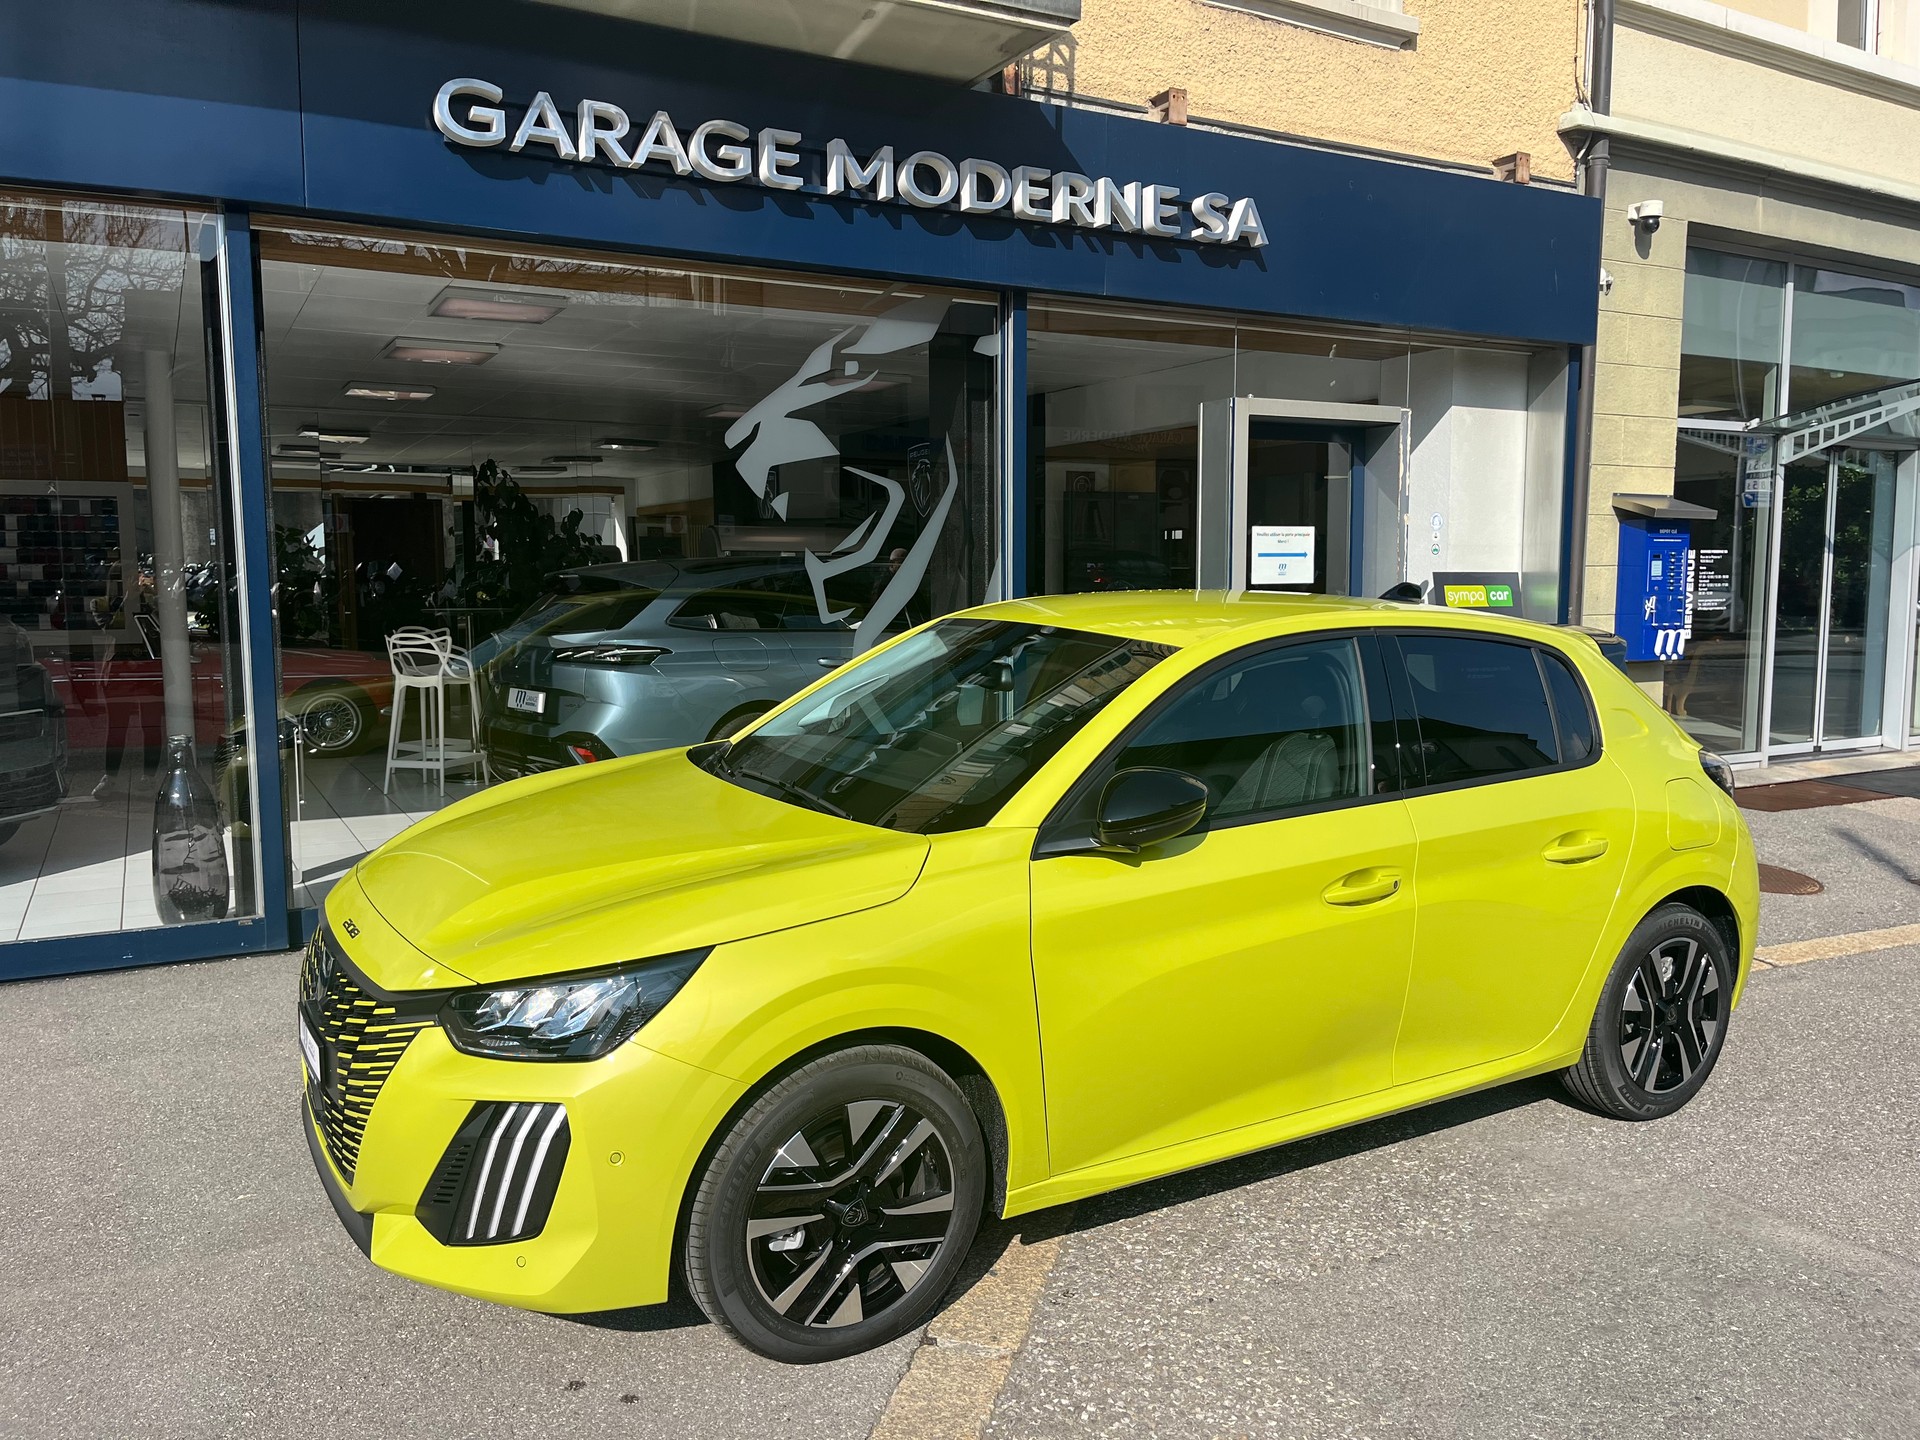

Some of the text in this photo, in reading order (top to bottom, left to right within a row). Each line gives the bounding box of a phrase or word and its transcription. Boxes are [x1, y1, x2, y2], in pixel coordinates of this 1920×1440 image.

[433, 77, 1269, 249] GARAGE MODERNE SA
[1447, 590, 1509, 605] sympa car
[1683, 549, 1696, 640] BIENVENUE
[342, 918, 361, 939] 208
